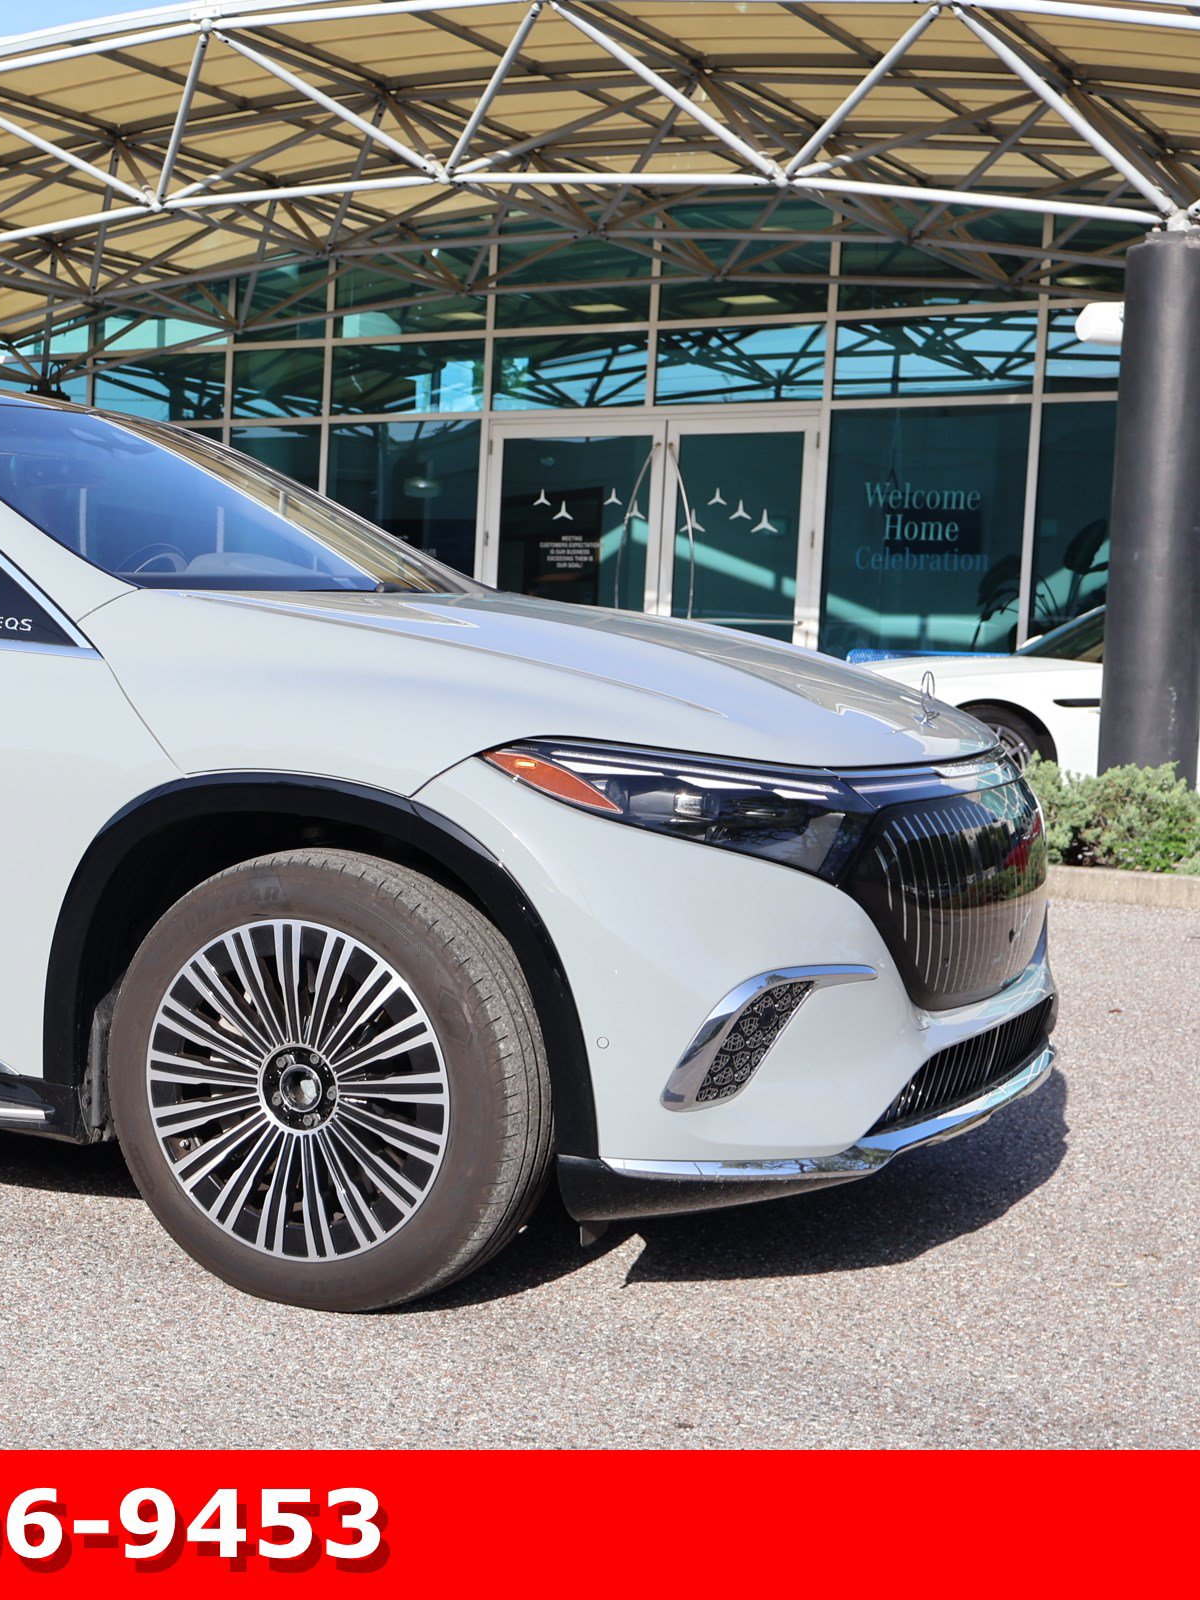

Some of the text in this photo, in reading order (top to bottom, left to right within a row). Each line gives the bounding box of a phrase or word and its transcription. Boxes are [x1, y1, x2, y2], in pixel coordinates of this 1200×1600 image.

[865, 481, 981, 511] Welcome
[883, 513, 959, 541] Home
[855, 546, 989, 571] Celebration
